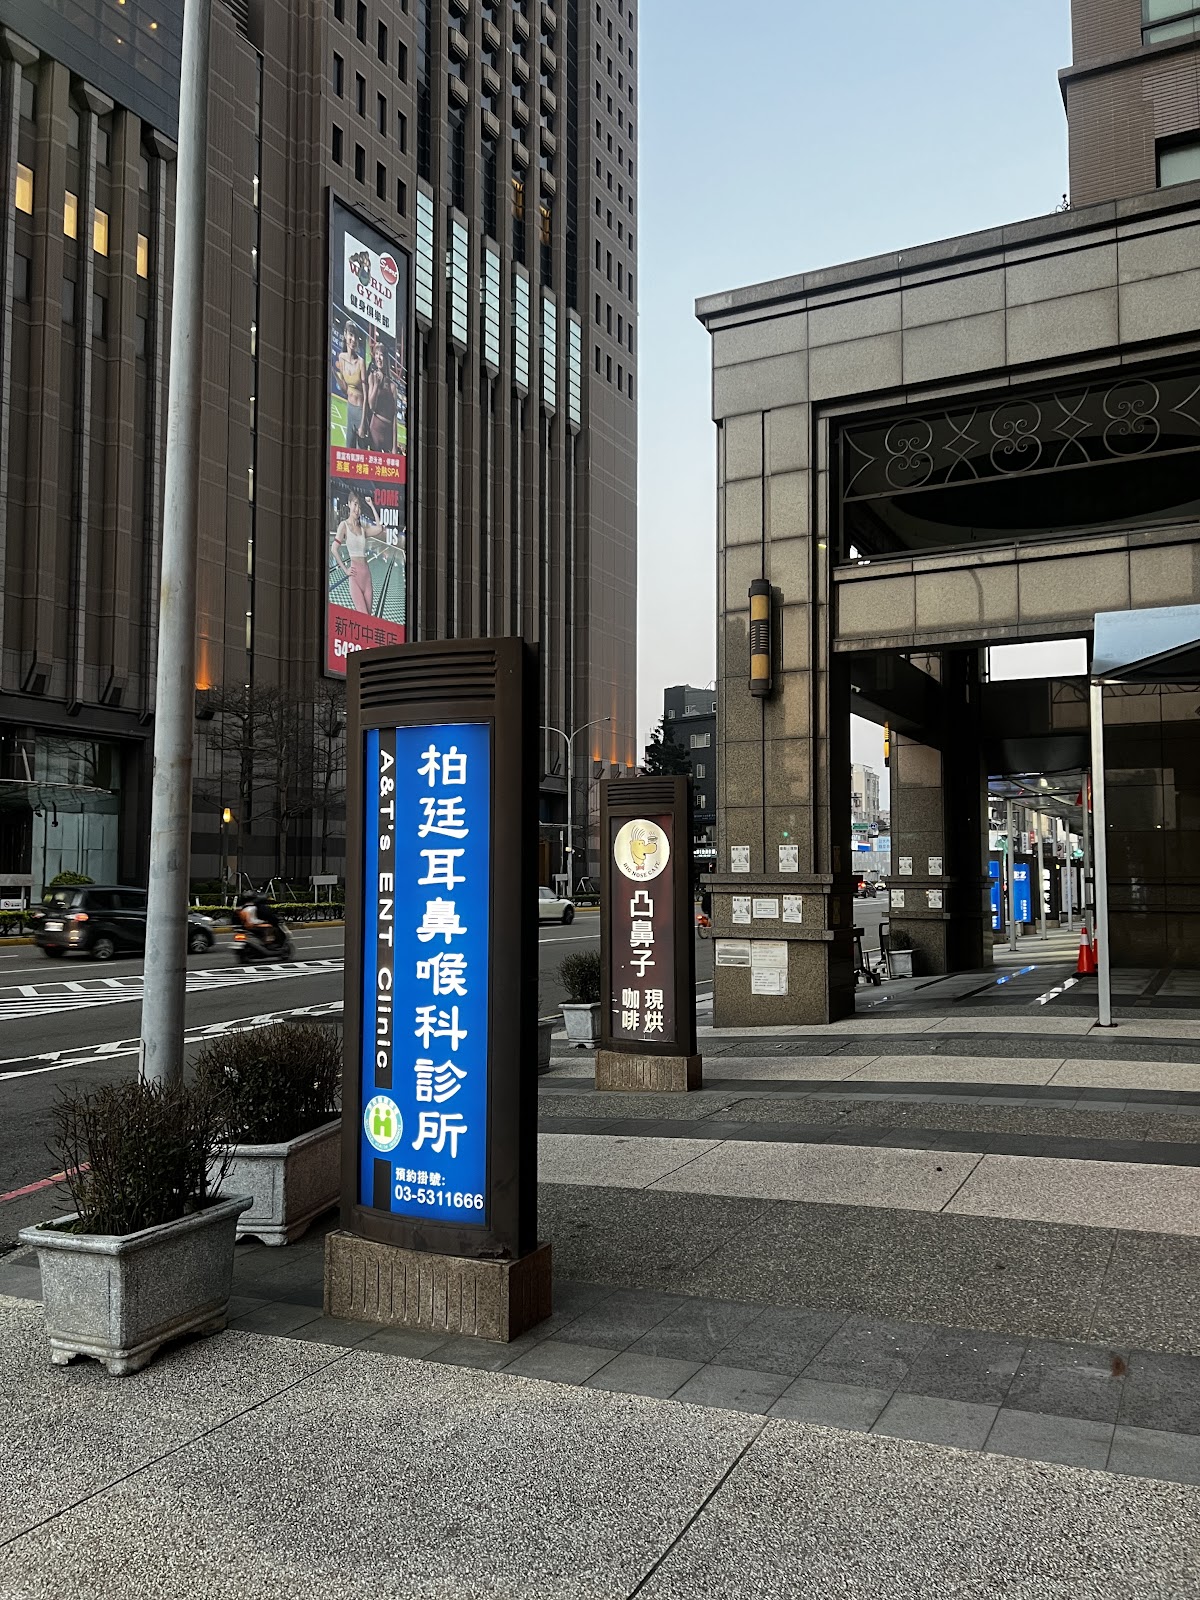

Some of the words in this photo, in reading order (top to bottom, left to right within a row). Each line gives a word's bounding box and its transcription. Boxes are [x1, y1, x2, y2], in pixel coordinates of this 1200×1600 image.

[356, 283, 383, 309] GYM
[374, 488, 399, 507] COME
[380, 508, 399, 526] JOIN
[386, 527, 399, 546] US
[379, 749, 395, 851] A&T's
[623, 862, 632, 873] BIG
[631, 871, 648, 879] NOSE
[378, 872, 394, 948] ENT
[411, 743, 470, 1160] 柏廷耳鼻喉科診所
[629, 890, 656, 978] 凸鼻子
[376, 966, 393, 1069] Clinic
[621, 987, 640, 1031] 咖啡
[643, 988, 664, 1033] 現烘
[395, 1167, 446, 1186] 預約掛號:
[394, 1184, 484, 1210] 03-5311666
